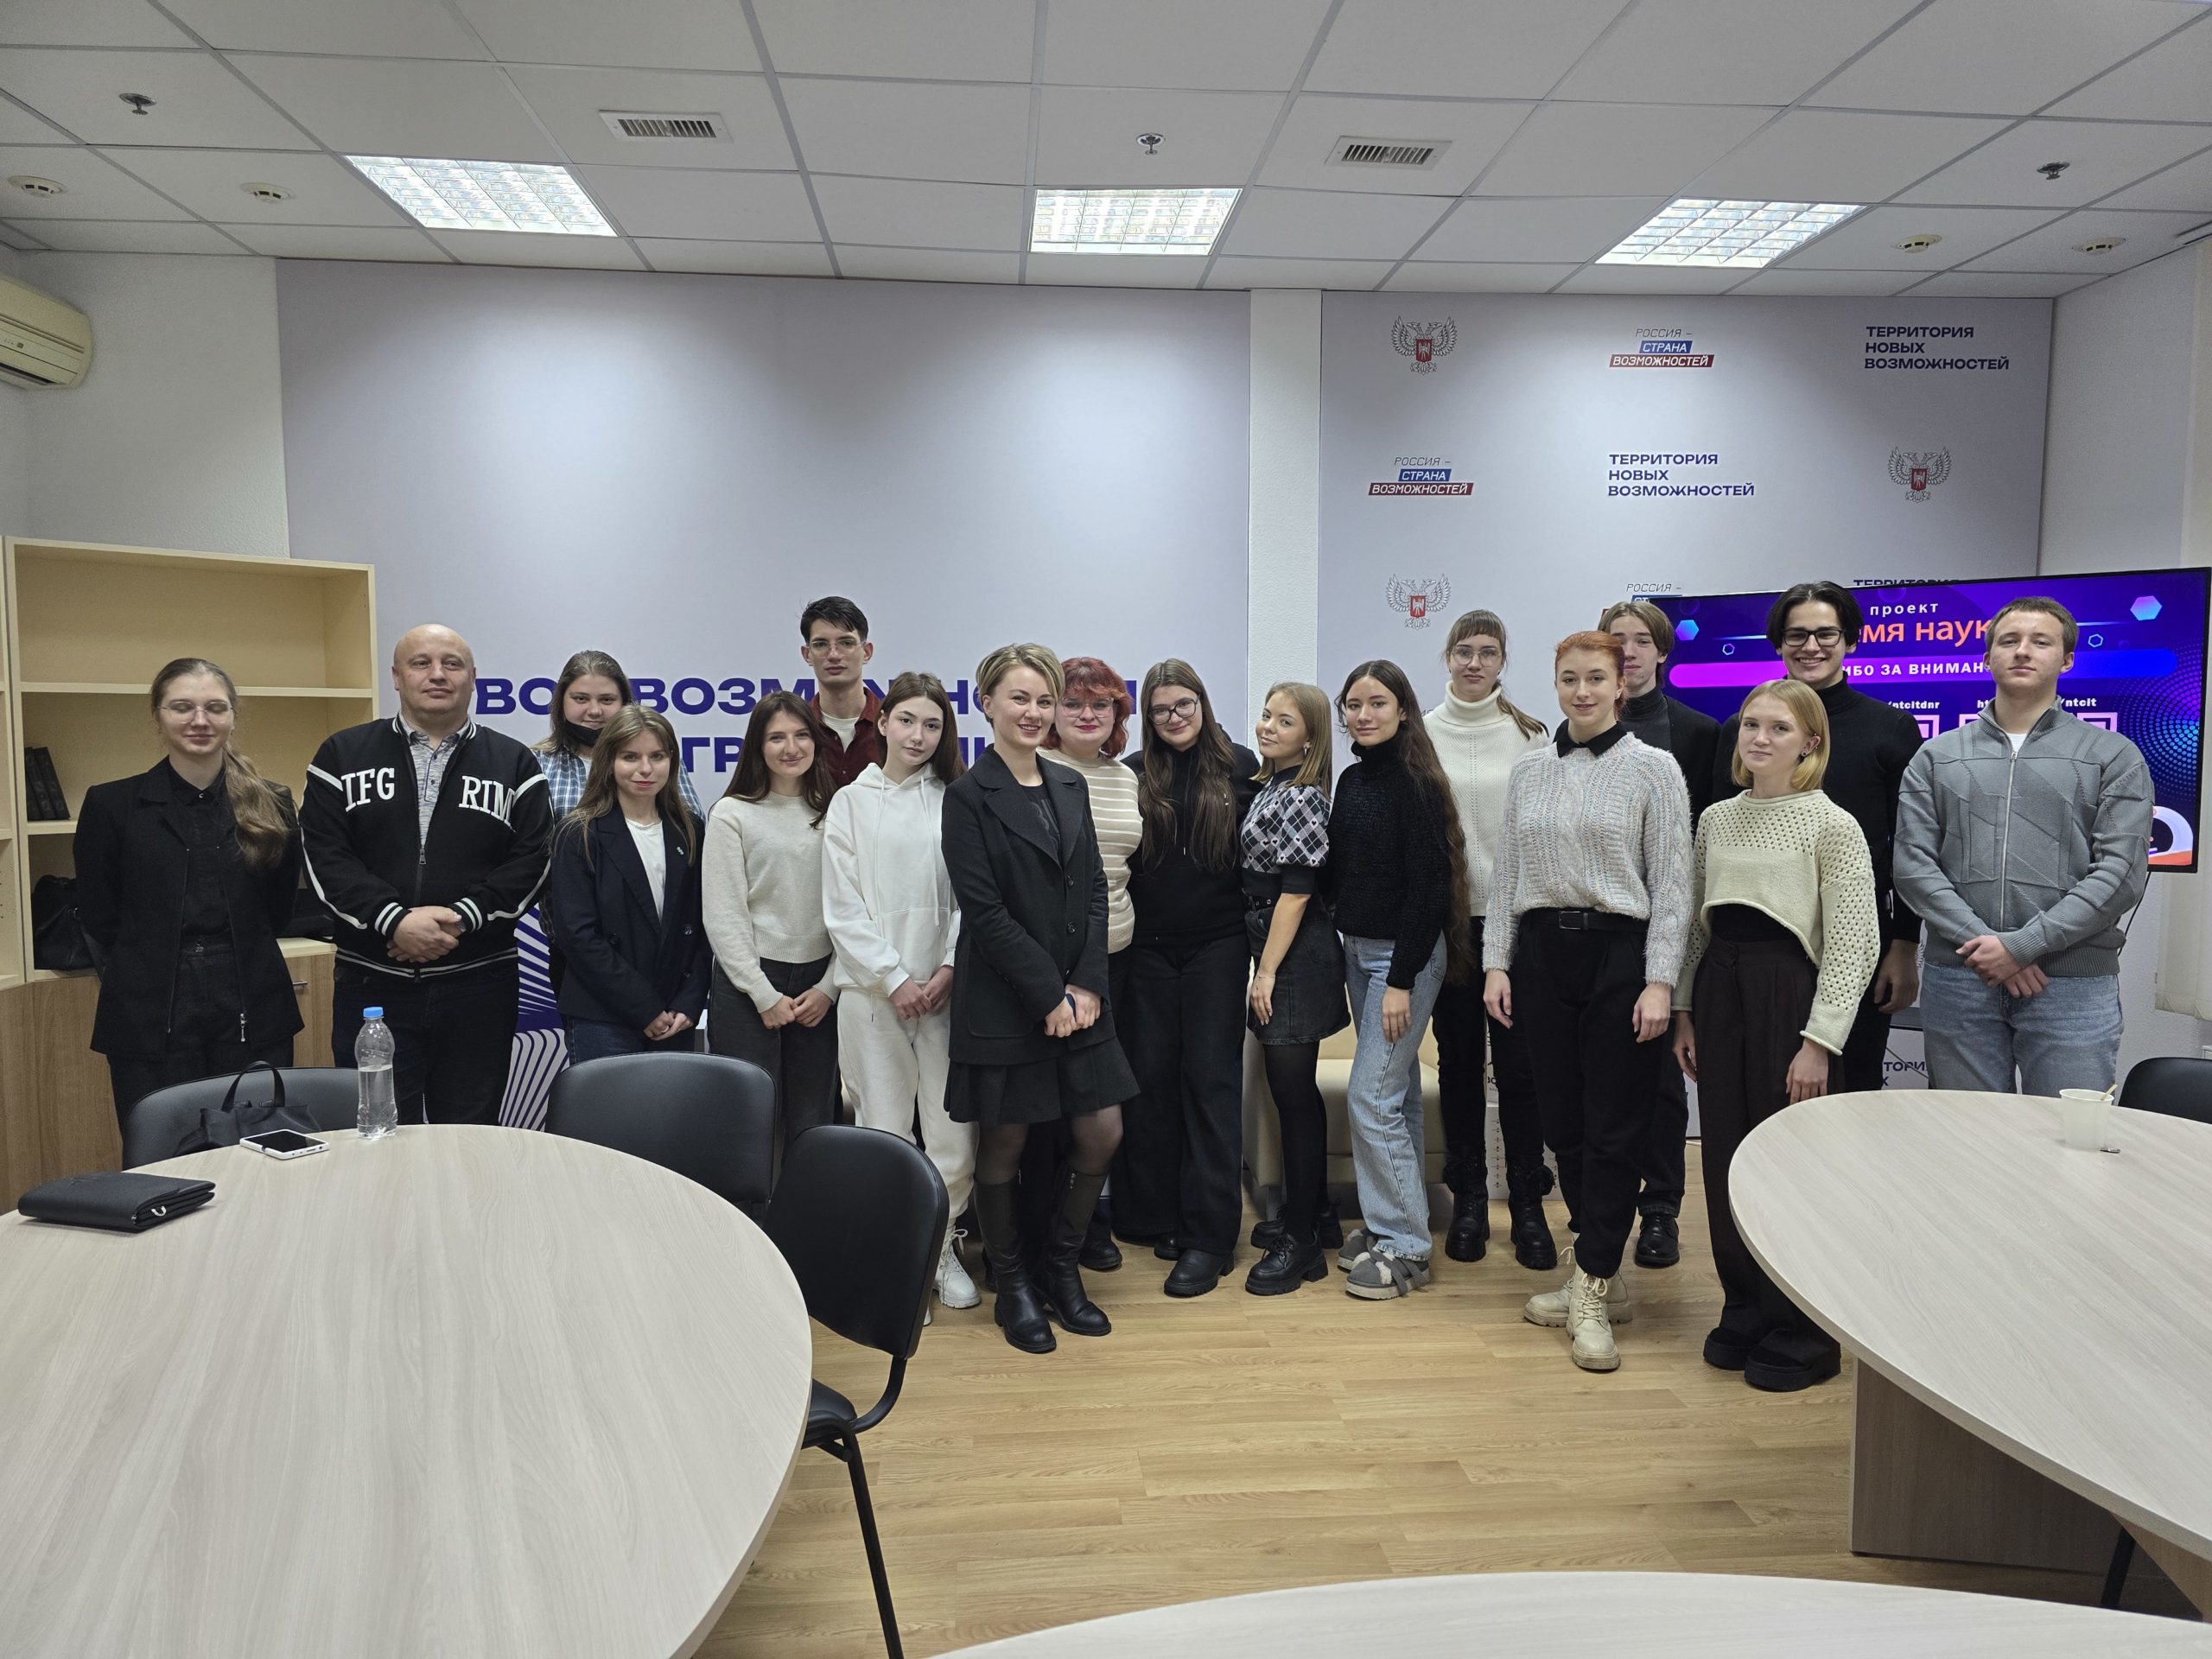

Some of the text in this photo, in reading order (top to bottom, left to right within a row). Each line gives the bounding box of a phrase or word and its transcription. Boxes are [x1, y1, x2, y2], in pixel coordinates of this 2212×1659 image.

[1635, 328, 1681, 338] РОССИЯ
[1866, 327, 1974, 338] ТЕРРИТОРИЯ
[1643, 342, 1687, 353] СТРАНА
[1865, 342, 1925, 353] НОВЫХ
[1613, 354, 1708, 366] ВОЗМОЖНОСТЕЙ
[1865, 356, 2010, 370] ВОЗМОЖНОСТЕЙ
[1394, 457, 1440, 467] РОССИЯ
[1609, 454, 1719, 465] ТЕРРИТОРИЯ
[1402, 471, 1446, 481] СТРАНА
[1608, 469, 1669, 481] НОВЫХ
[1372, 483, 1468, 494] ВОЗМОЖНОСТЕЙ
[1608, 482, 1755, 497] ВОЗМОЖНОСТЕЙ
[1626, 583, 1672, 593] РОССИЯ
[1870, 603, 1939, 618] проект
[1858, 619, 1992, 647] мя наук
[1842, 662, 1984, 677] ИБО ЗА ВНИМАН
